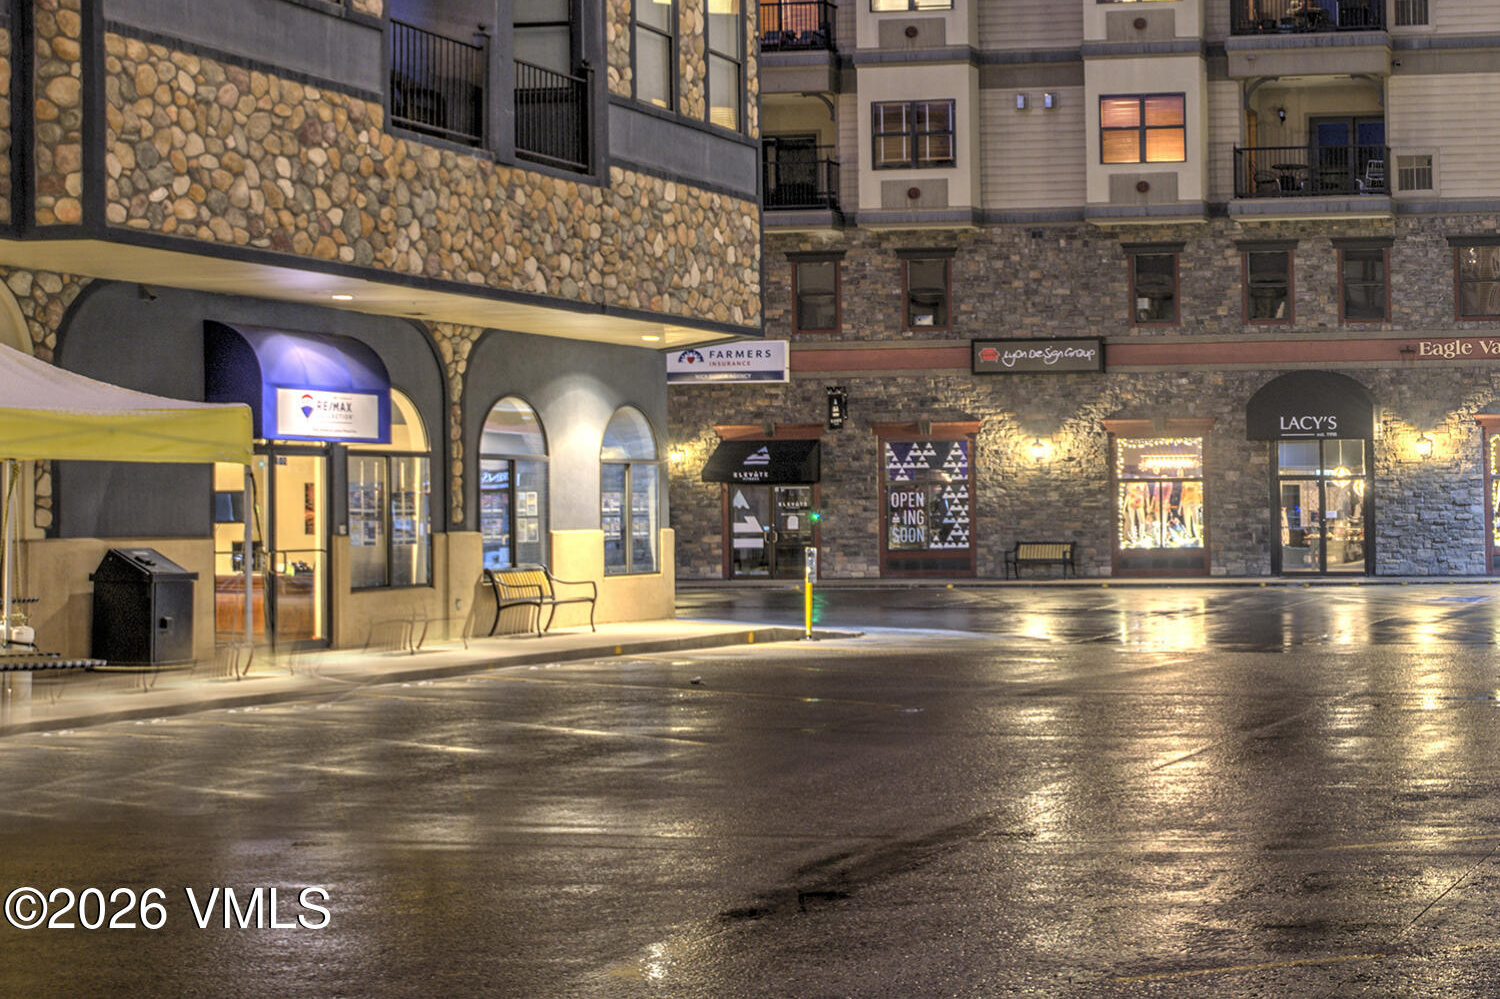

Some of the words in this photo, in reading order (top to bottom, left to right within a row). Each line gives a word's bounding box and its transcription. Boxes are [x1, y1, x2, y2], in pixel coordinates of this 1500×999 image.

[709, 349, 772, 359] FARMERS
[1064, 347, 1095, 361] Group
[1419, 339, 1473, 359] Eagle
[316, 400, 353, 412] RE/MAX
[1280, 416, 1337, 430] LACY'S
[891, 492, 925, 508] OPEN
[891, 527, 925, 543] SOON
